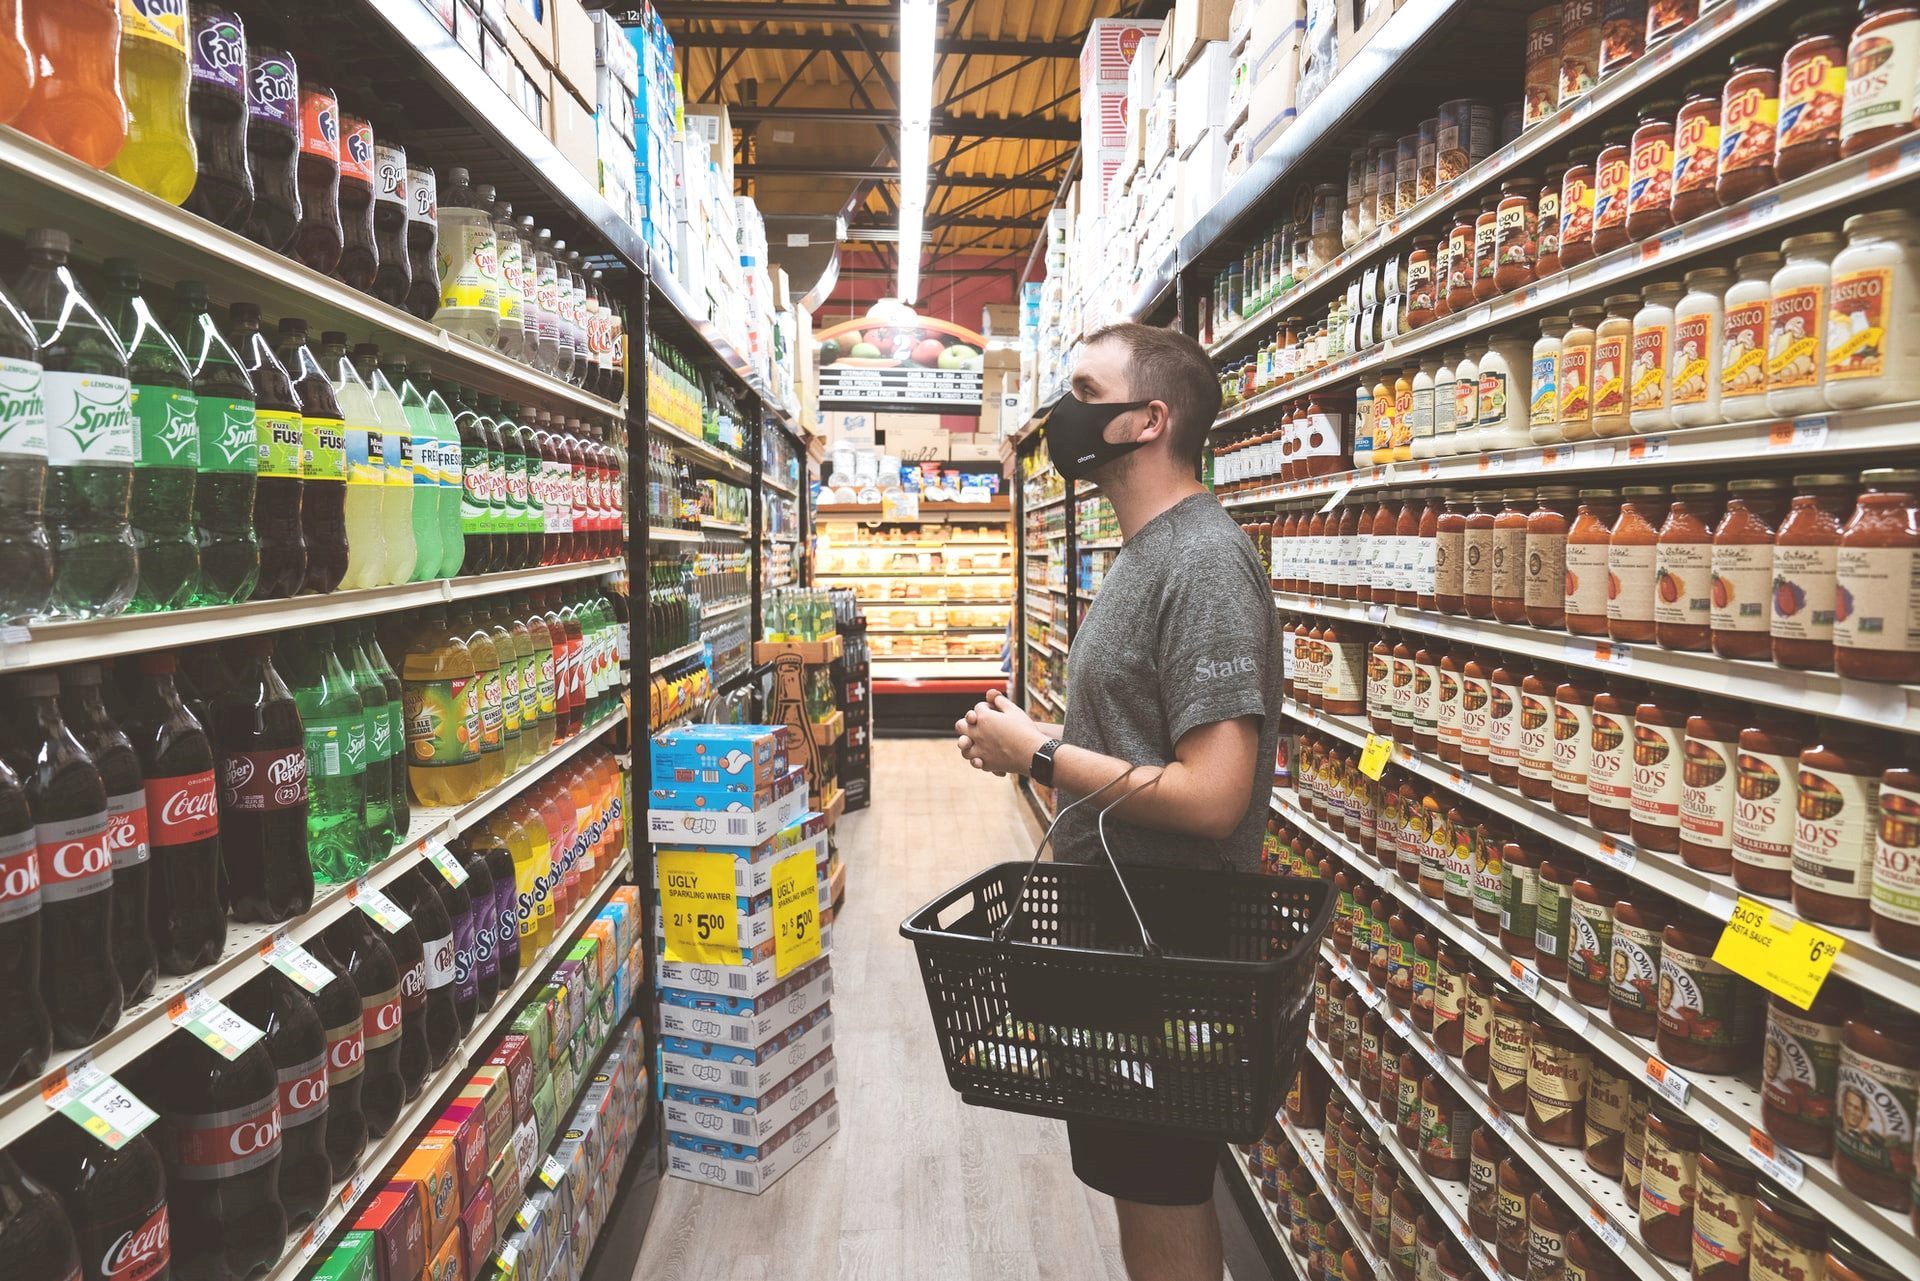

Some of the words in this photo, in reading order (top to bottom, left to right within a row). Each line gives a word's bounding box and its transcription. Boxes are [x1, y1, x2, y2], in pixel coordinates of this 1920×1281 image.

[284, 789, 294, 799] 23
[652, 823, 661, 831] 24
[668, 875, 698, 889] UGLY
[777, 880, 795, 899] UGLY
[669, 889, 705, 900] SPARKLING
[706, 892, 731, 901] WATER
[778, 892, 800, 909] SPARKLING
[800, 885, 815, 899] WATER
[674, 913, 683, 927] 2/
[1732, 906, 1763, 928] RAO'S
[781, 923, 789, 938] 2/
[1580, 922, 1596, 951] OWN
[1727, 920, 1748, 936] PASTA
[1749, 932, 1773, 948] SAUCE
[1633, 950, 1654, 980] OWN
[1679, 977, 1700, 1008] OWN
[1495, 1037, 1526, 1053] Organic
[1786, 1043, 1811, 1081] OWN
[1874, 1092, 1906, 1135] OWN
